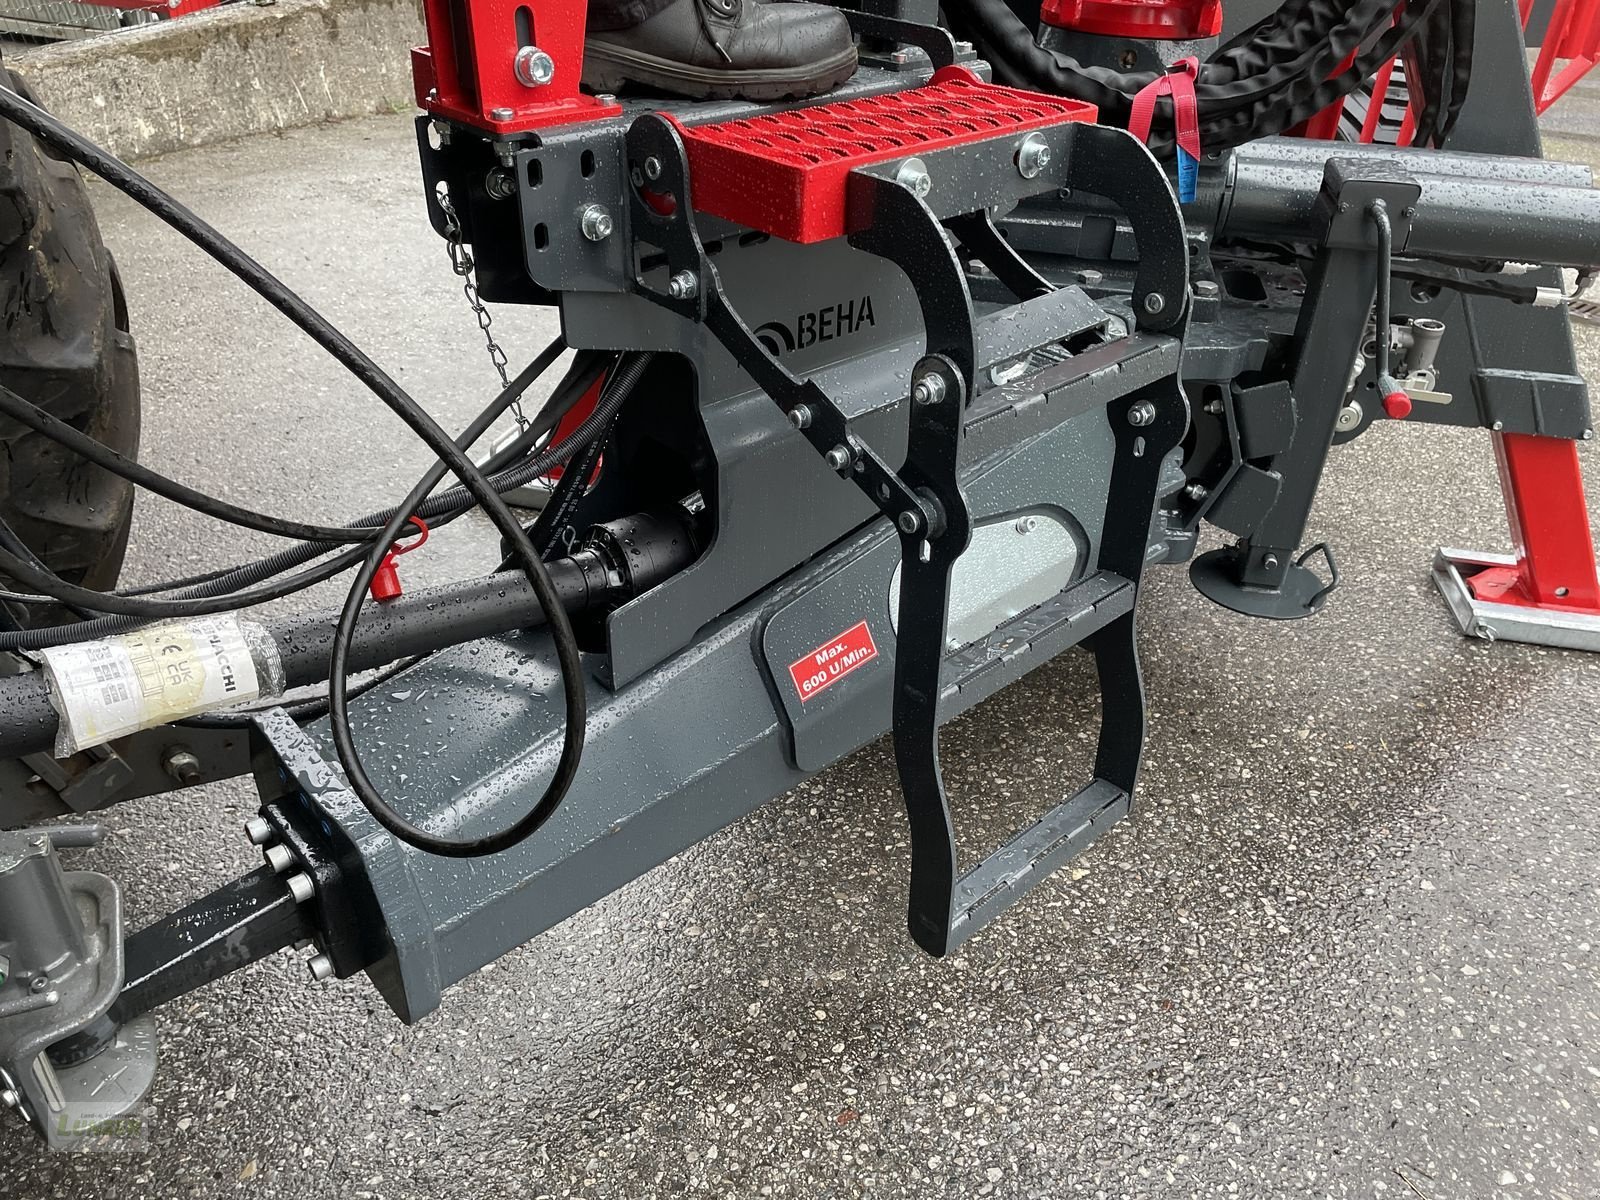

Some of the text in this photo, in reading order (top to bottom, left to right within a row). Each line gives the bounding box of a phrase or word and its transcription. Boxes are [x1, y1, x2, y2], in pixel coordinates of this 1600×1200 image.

[797, 296, 875, 349] BEHA
[802, 646, 872, 692] 600 U/Min.
[815, 642, 848, 665] Max.
